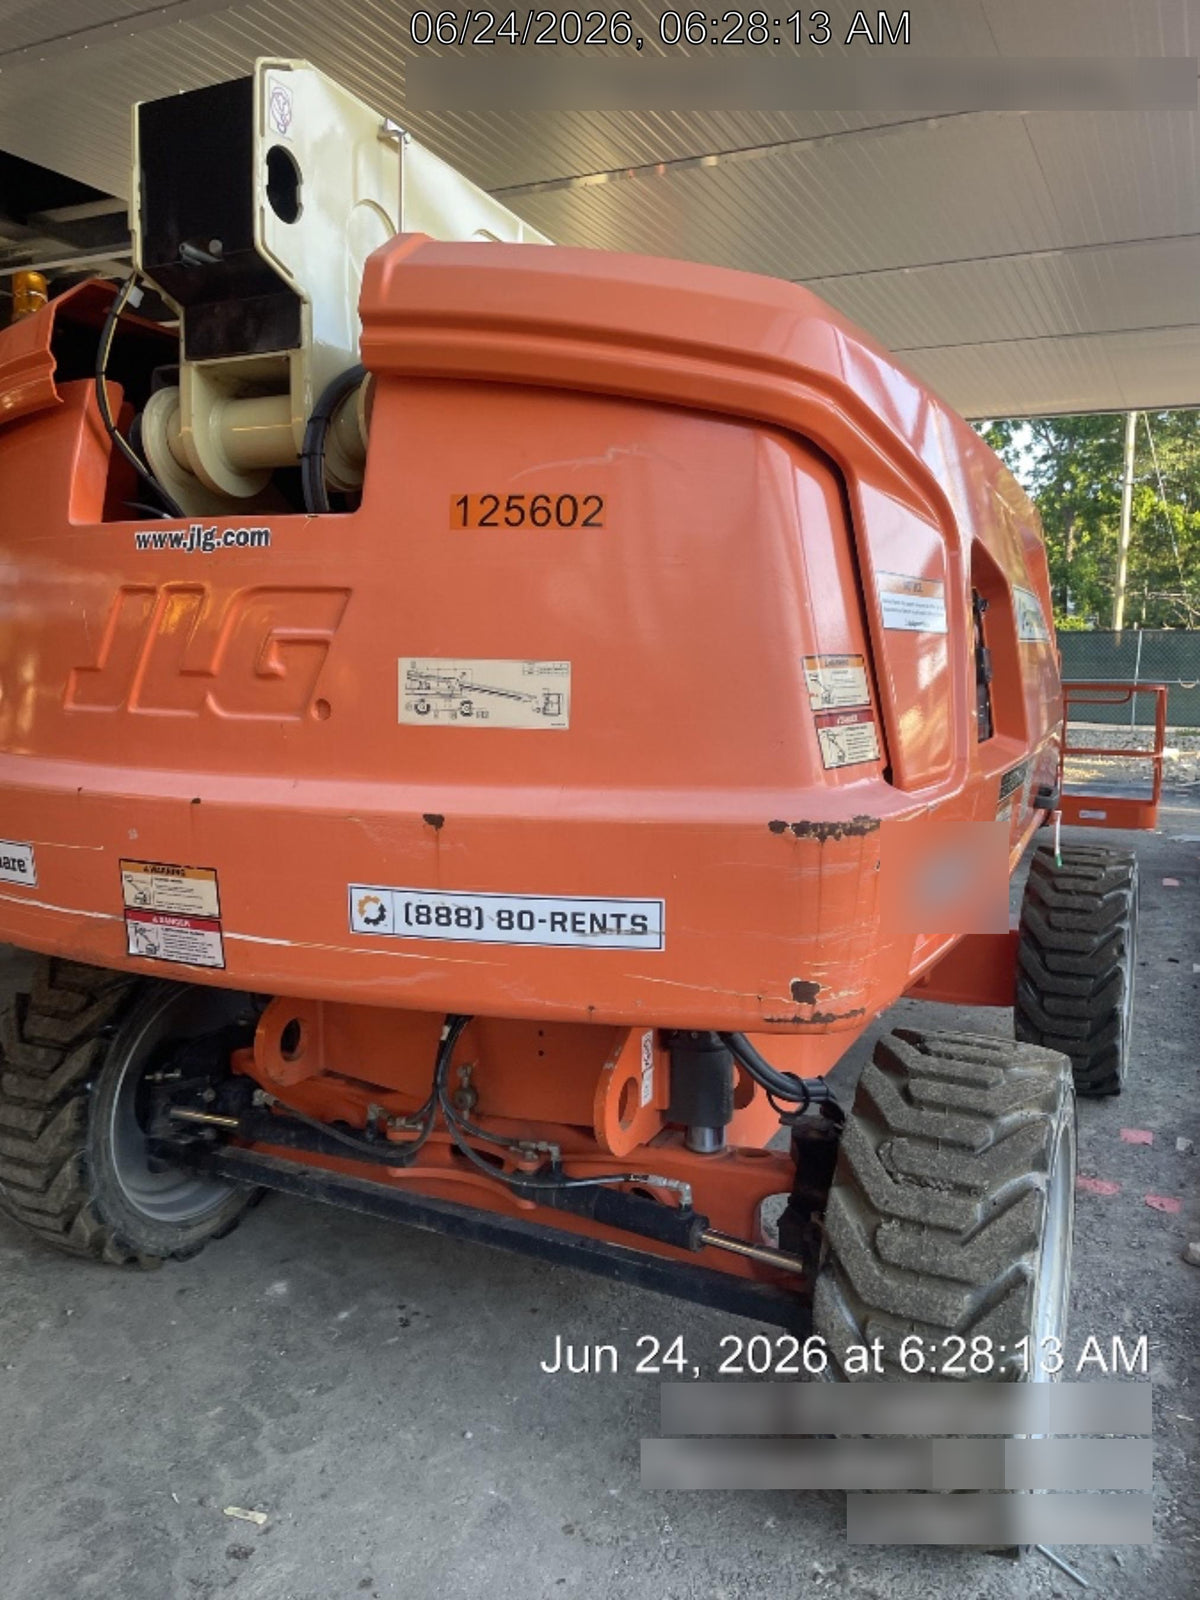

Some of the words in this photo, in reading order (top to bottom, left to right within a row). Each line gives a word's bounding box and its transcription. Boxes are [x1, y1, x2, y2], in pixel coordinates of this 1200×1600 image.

[456, 494, 604, 527] 125602
[135, 525, 271, 552] www.jlg.com
[496, 909, 649, 935] 80-RENTS
